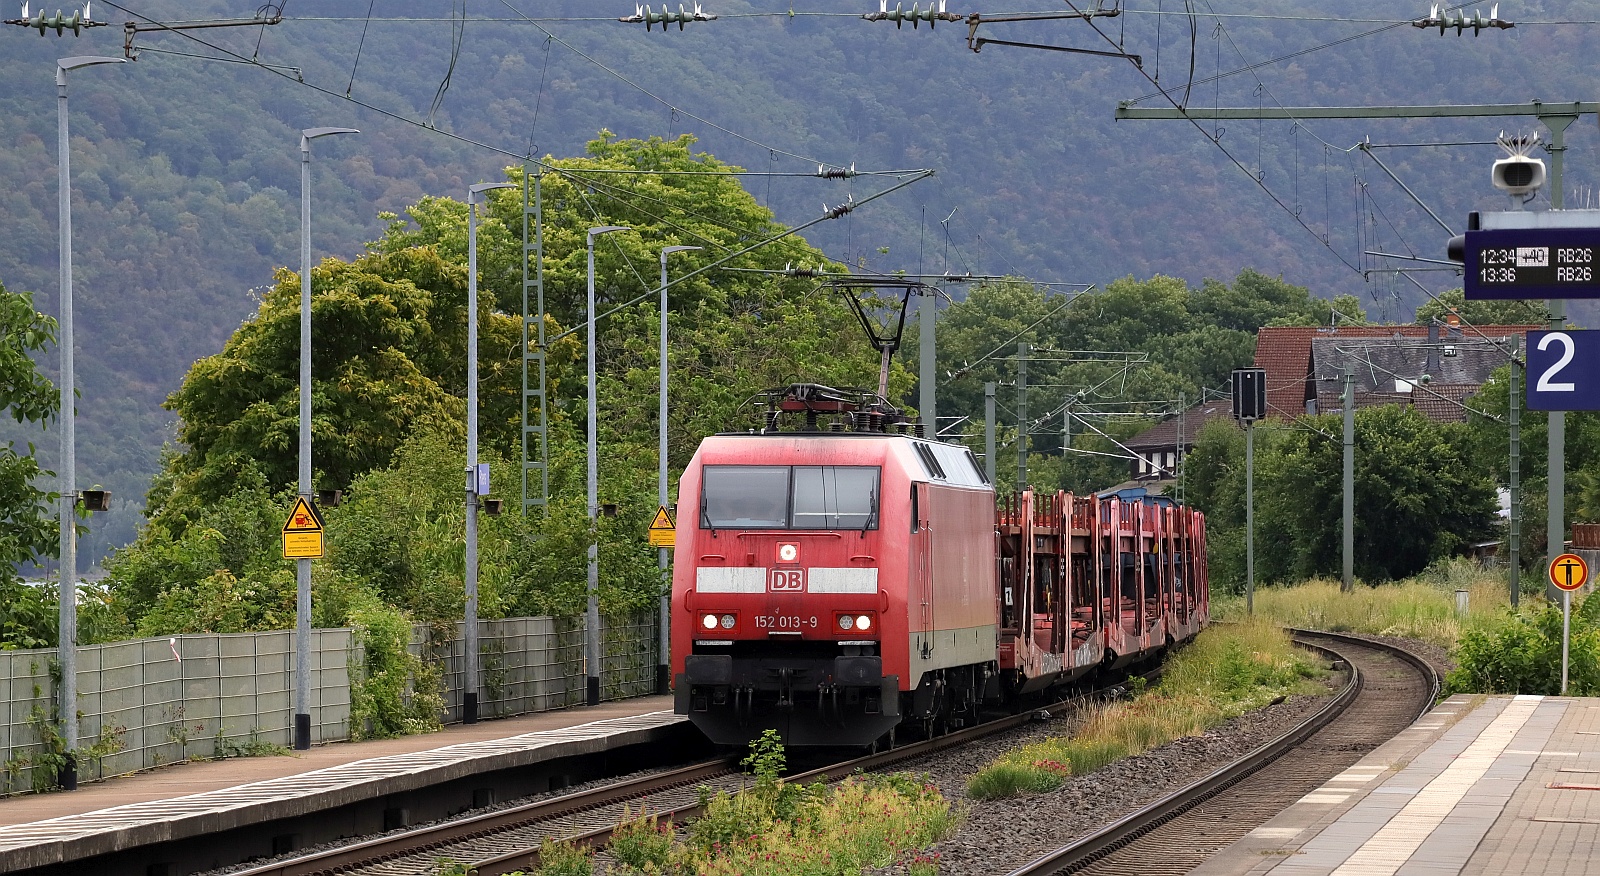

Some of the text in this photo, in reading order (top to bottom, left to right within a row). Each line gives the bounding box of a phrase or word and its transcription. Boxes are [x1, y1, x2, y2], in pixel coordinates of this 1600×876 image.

[1480, 248, 1592, 263] 12:34 +40 RB26
[1480, 267, 1592, 282] 13:36 RB26
[1537, 332, 1575, 392] 2
[773, 571, 801, 589] DB
[754, 615, 818, 628] 152 013-9
